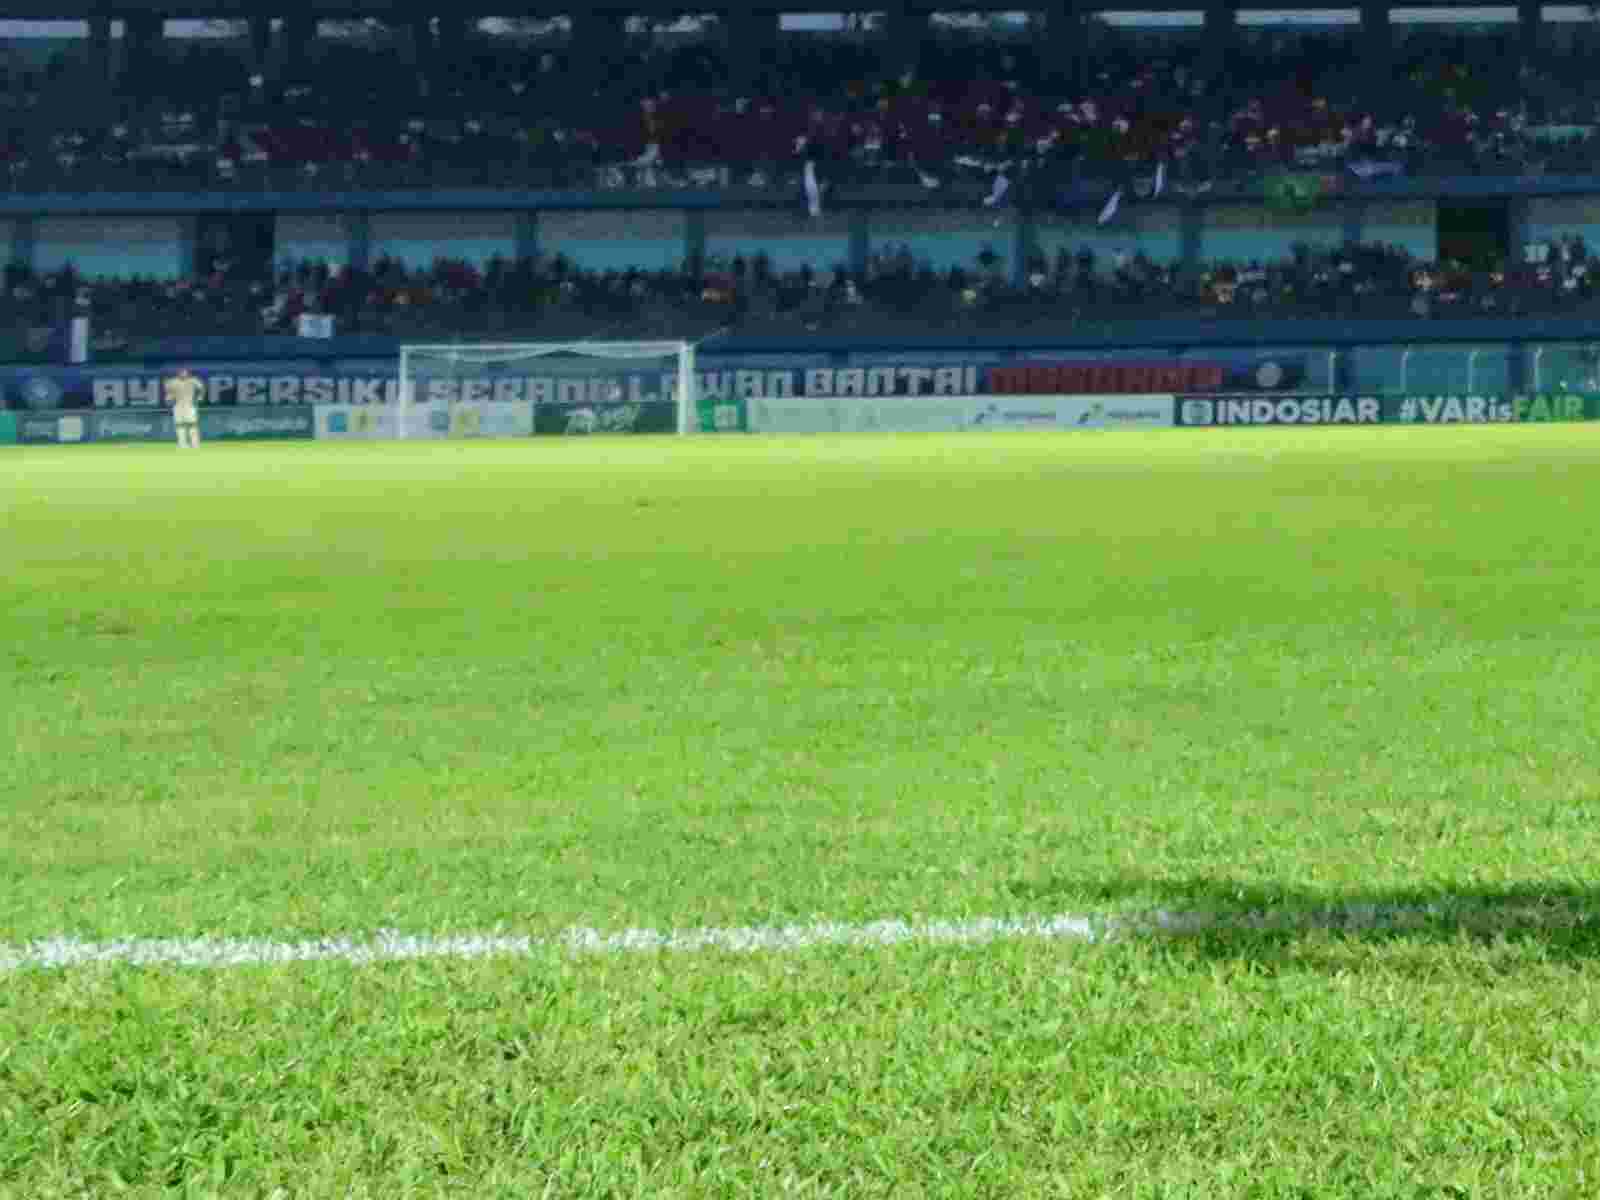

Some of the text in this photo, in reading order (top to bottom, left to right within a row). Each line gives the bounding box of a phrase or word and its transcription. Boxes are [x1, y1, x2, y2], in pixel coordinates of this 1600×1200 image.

[92, 377, 164, 407] AY
[1216, 398, 1380, 424] INDOSIAR
[1399, 394, 1584, 424] #VARisFAIR
